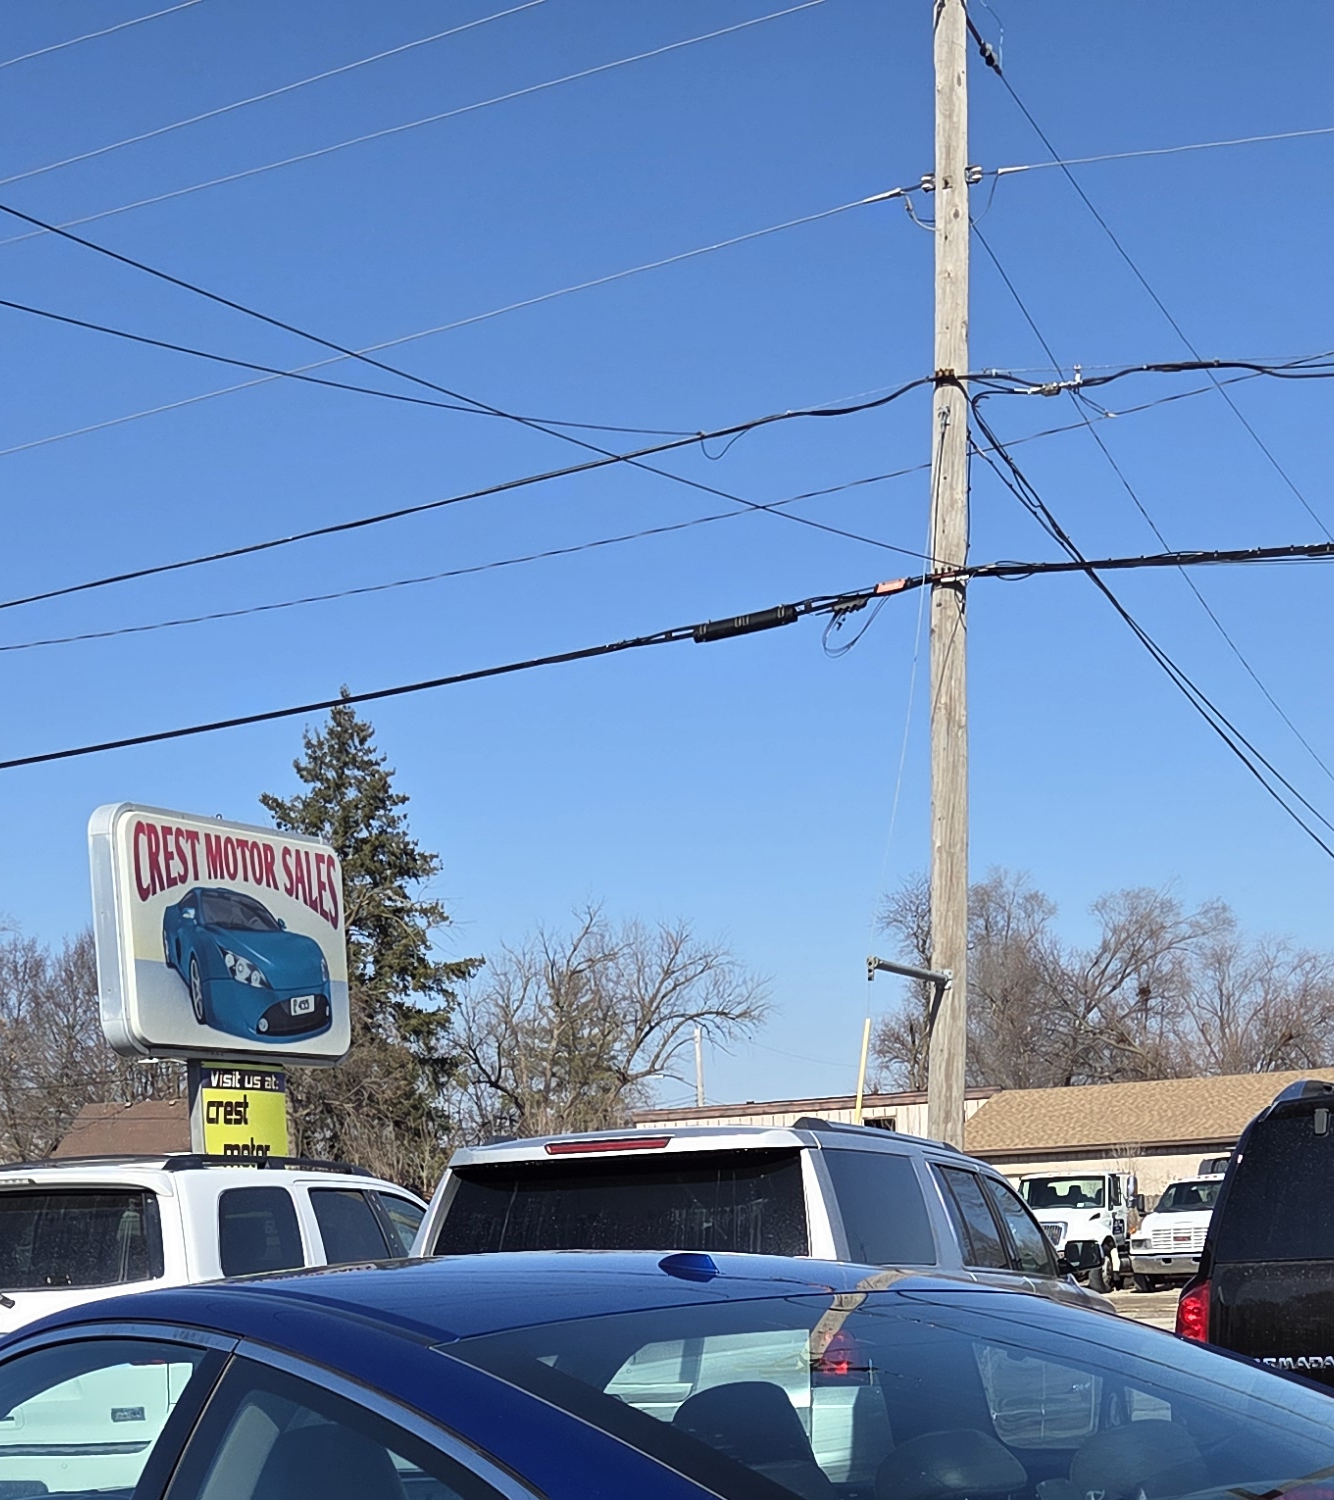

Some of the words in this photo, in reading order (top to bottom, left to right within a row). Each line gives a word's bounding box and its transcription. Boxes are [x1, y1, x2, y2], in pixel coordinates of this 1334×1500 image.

[133, 820, 201, 902] CREST
[204, 832, 280, 892] MOTOR
[281, 846, 339, 930] SALES
[210, 1071, 241, 1088] Visit
[244, 1074, 261, 1088] us
[264, 1074, 279, 1090] at:
[206, 1094, 249, 1125] crest
